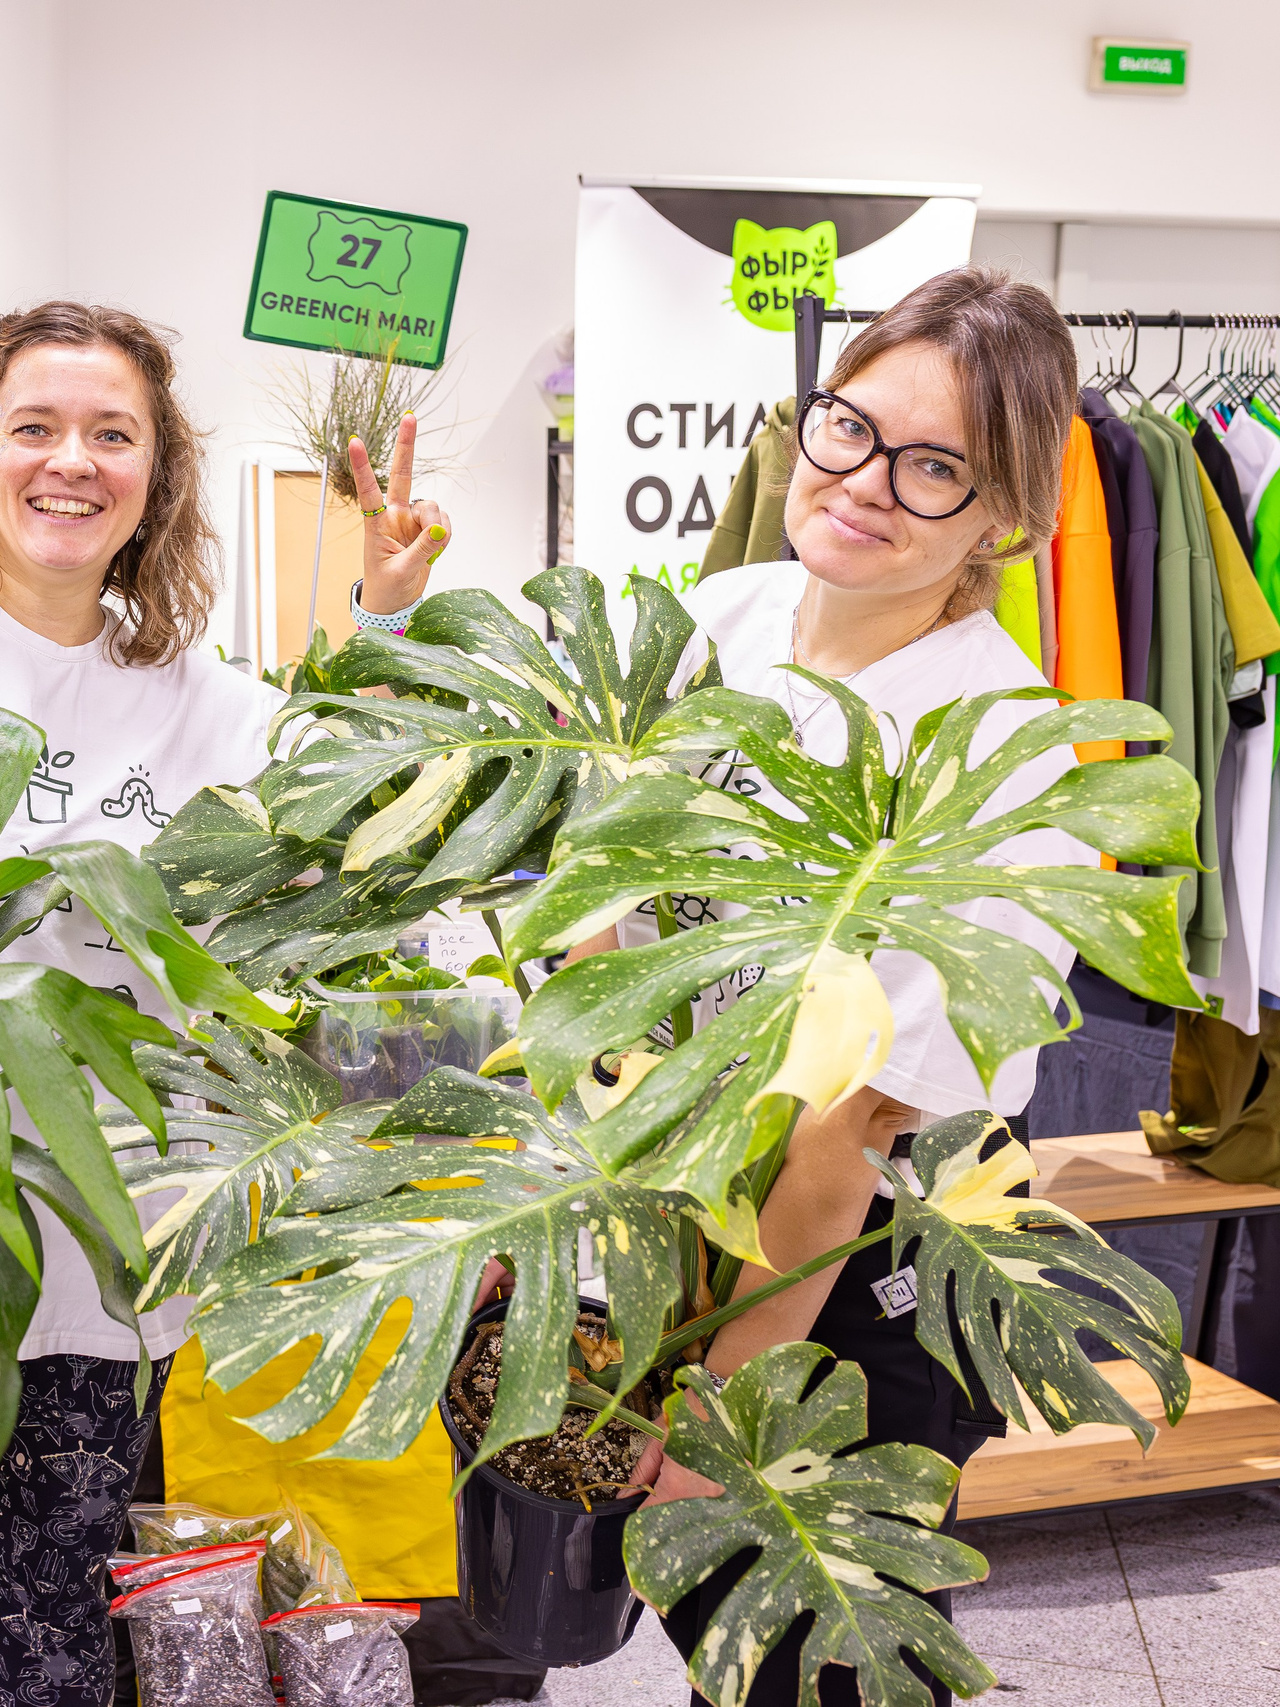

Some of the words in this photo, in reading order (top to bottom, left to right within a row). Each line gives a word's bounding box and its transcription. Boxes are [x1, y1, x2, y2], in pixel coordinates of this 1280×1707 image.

[1118, 56, 1172, 75] ВЫХОД
[336, 234, 382, 270] 27
[741, 250, 808, 280] ФЫР
[260, 291, 370, 327] GREENCH
[378, 311, 436, 338] MARI
[625, 474, 736, 538] ОД
